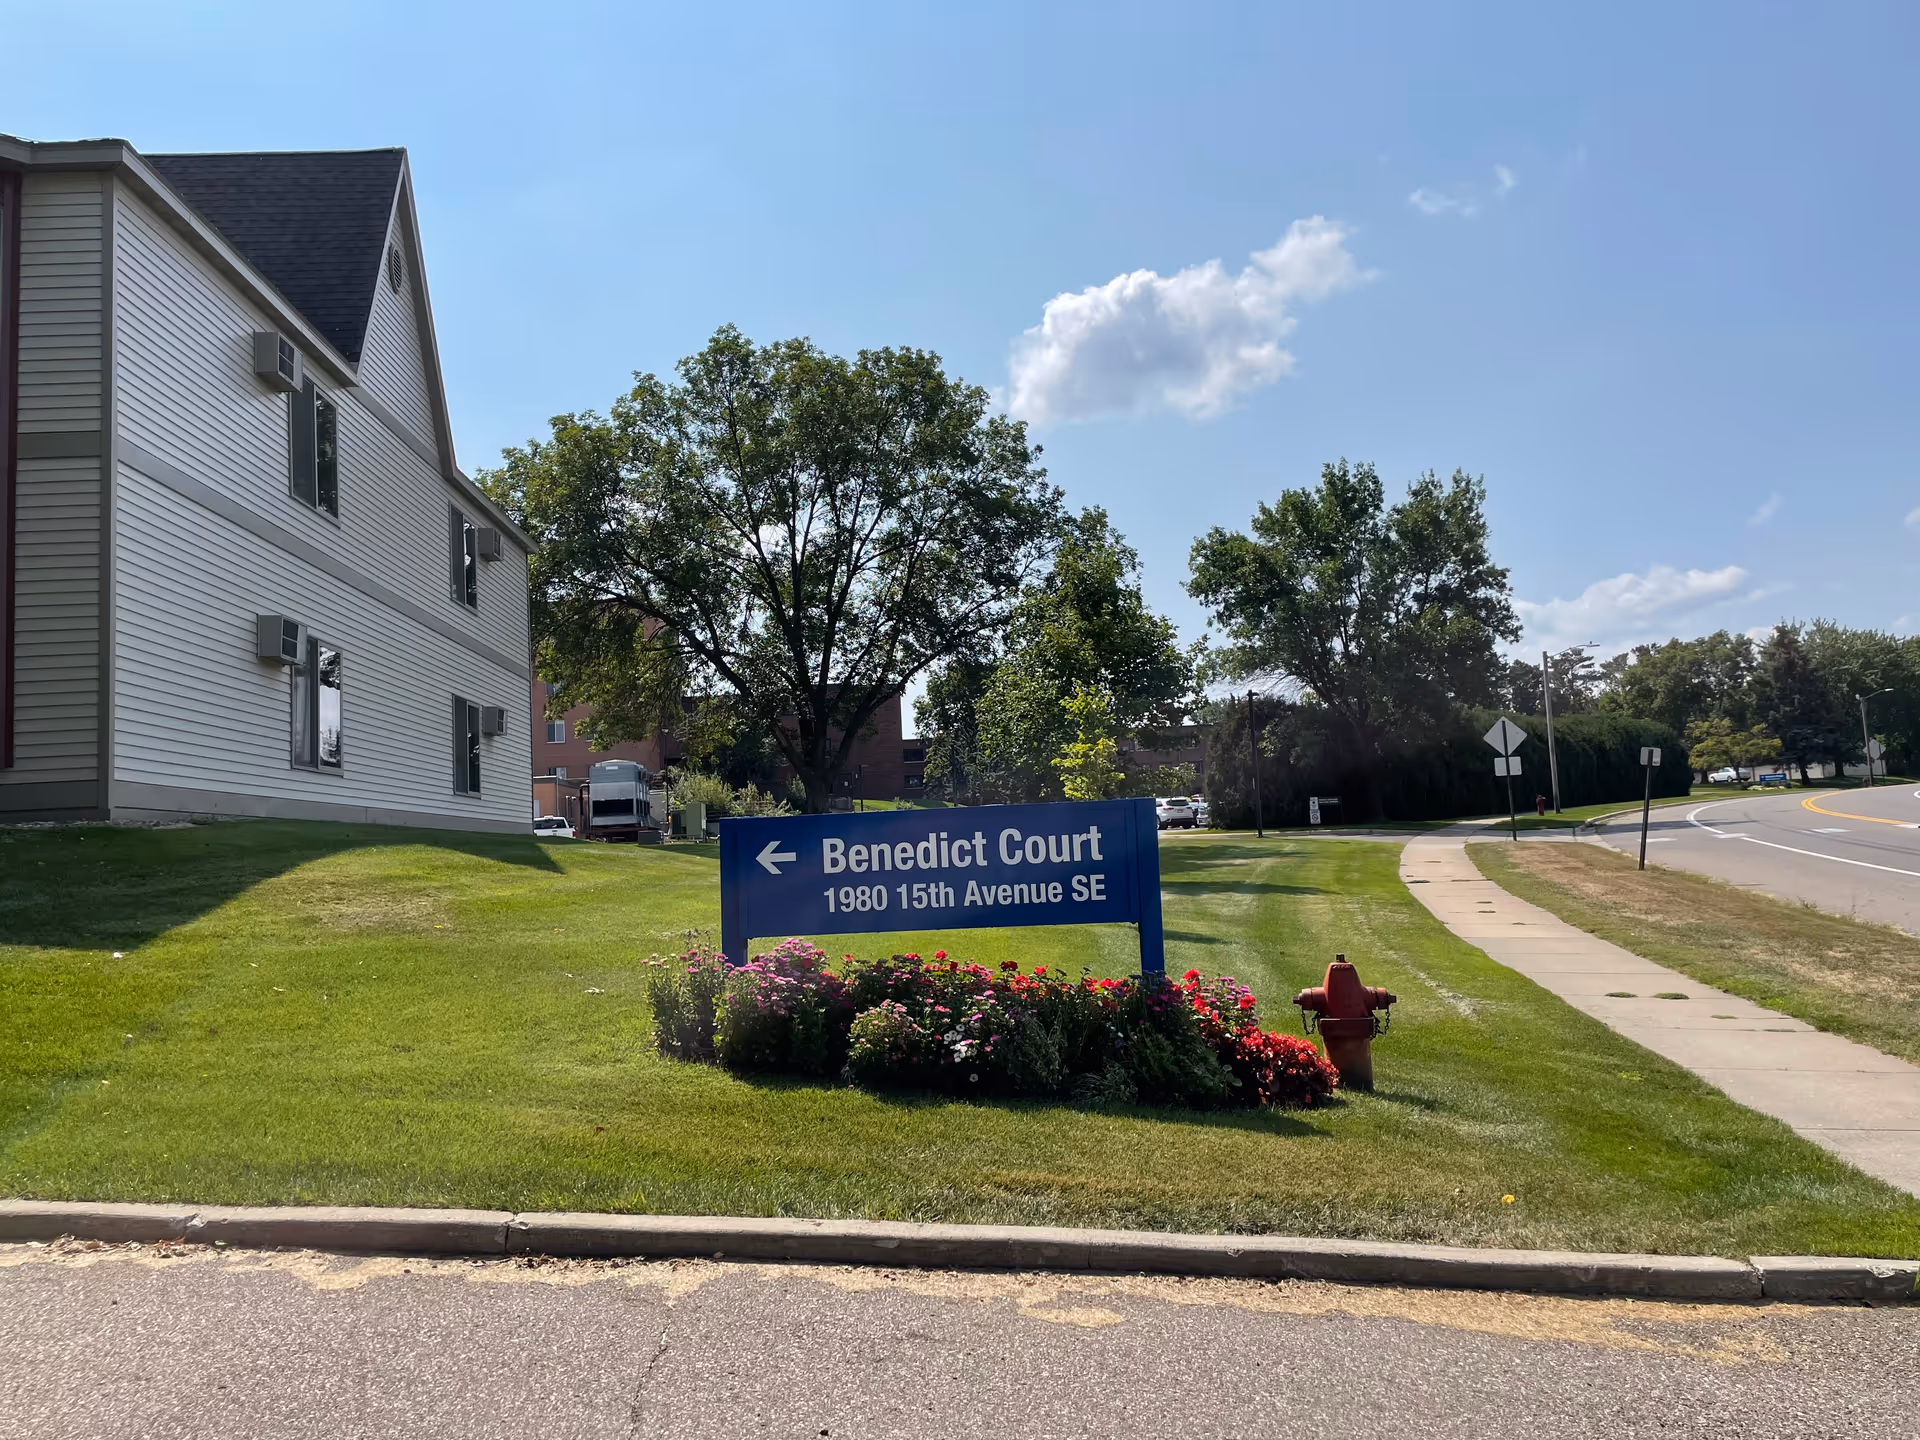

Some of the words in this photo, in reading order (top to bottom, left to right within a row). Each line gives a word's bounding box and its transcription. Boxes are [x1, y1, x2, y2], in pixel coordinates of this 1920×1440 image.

[822, 831, 988, 874] Benedict
[998, 825, 1103, 865] Court
[823, 884, 888, 913] 1980
[896, 880, 955, 910] 15th
[963, 880, 1063, 907] Avenue
[1071, 874, 1107, 902] SE
